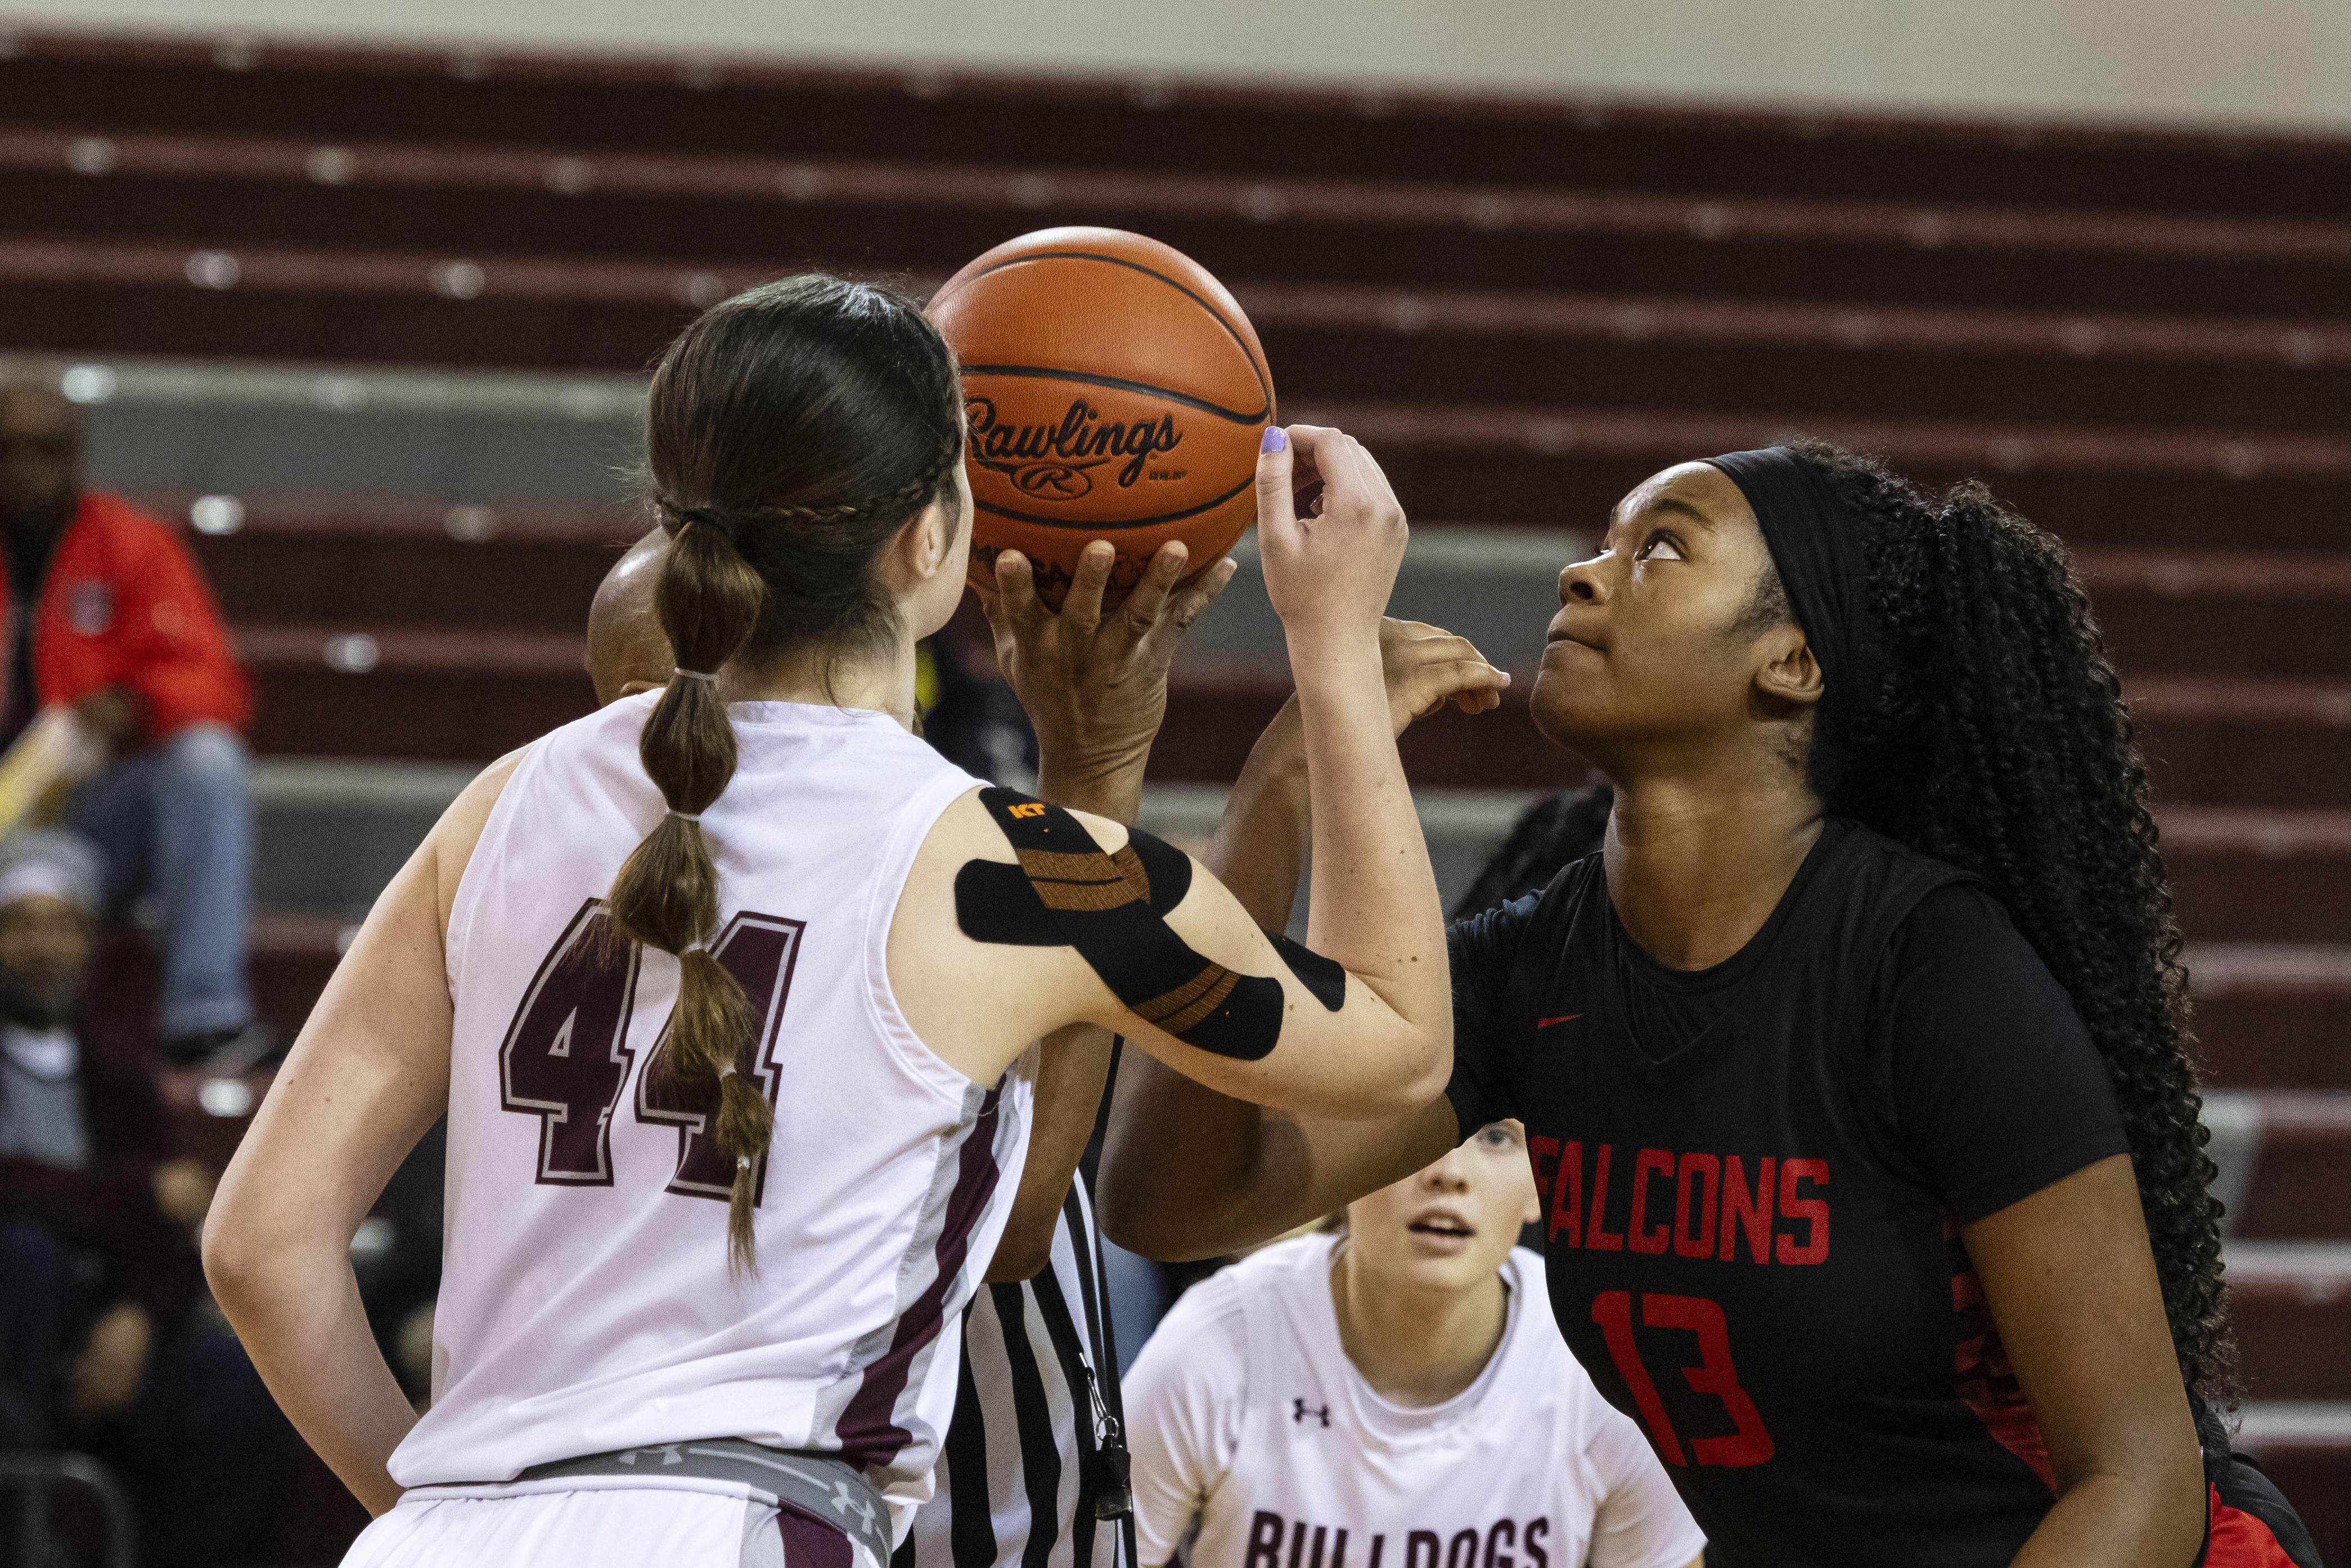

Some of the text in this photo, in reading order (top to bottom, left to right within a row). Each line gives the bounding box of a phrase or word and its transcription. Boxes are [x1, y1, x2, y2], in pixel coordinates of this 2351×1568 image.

[964, 397, 1181, 488] Rawlings
[1007, 803, 1046, 819] KT
[498, 897, 807, 1208] 44
[1530, 1135, 1829, 1265] FALCONS
[1592, 1291, 1775, 1467] 13
